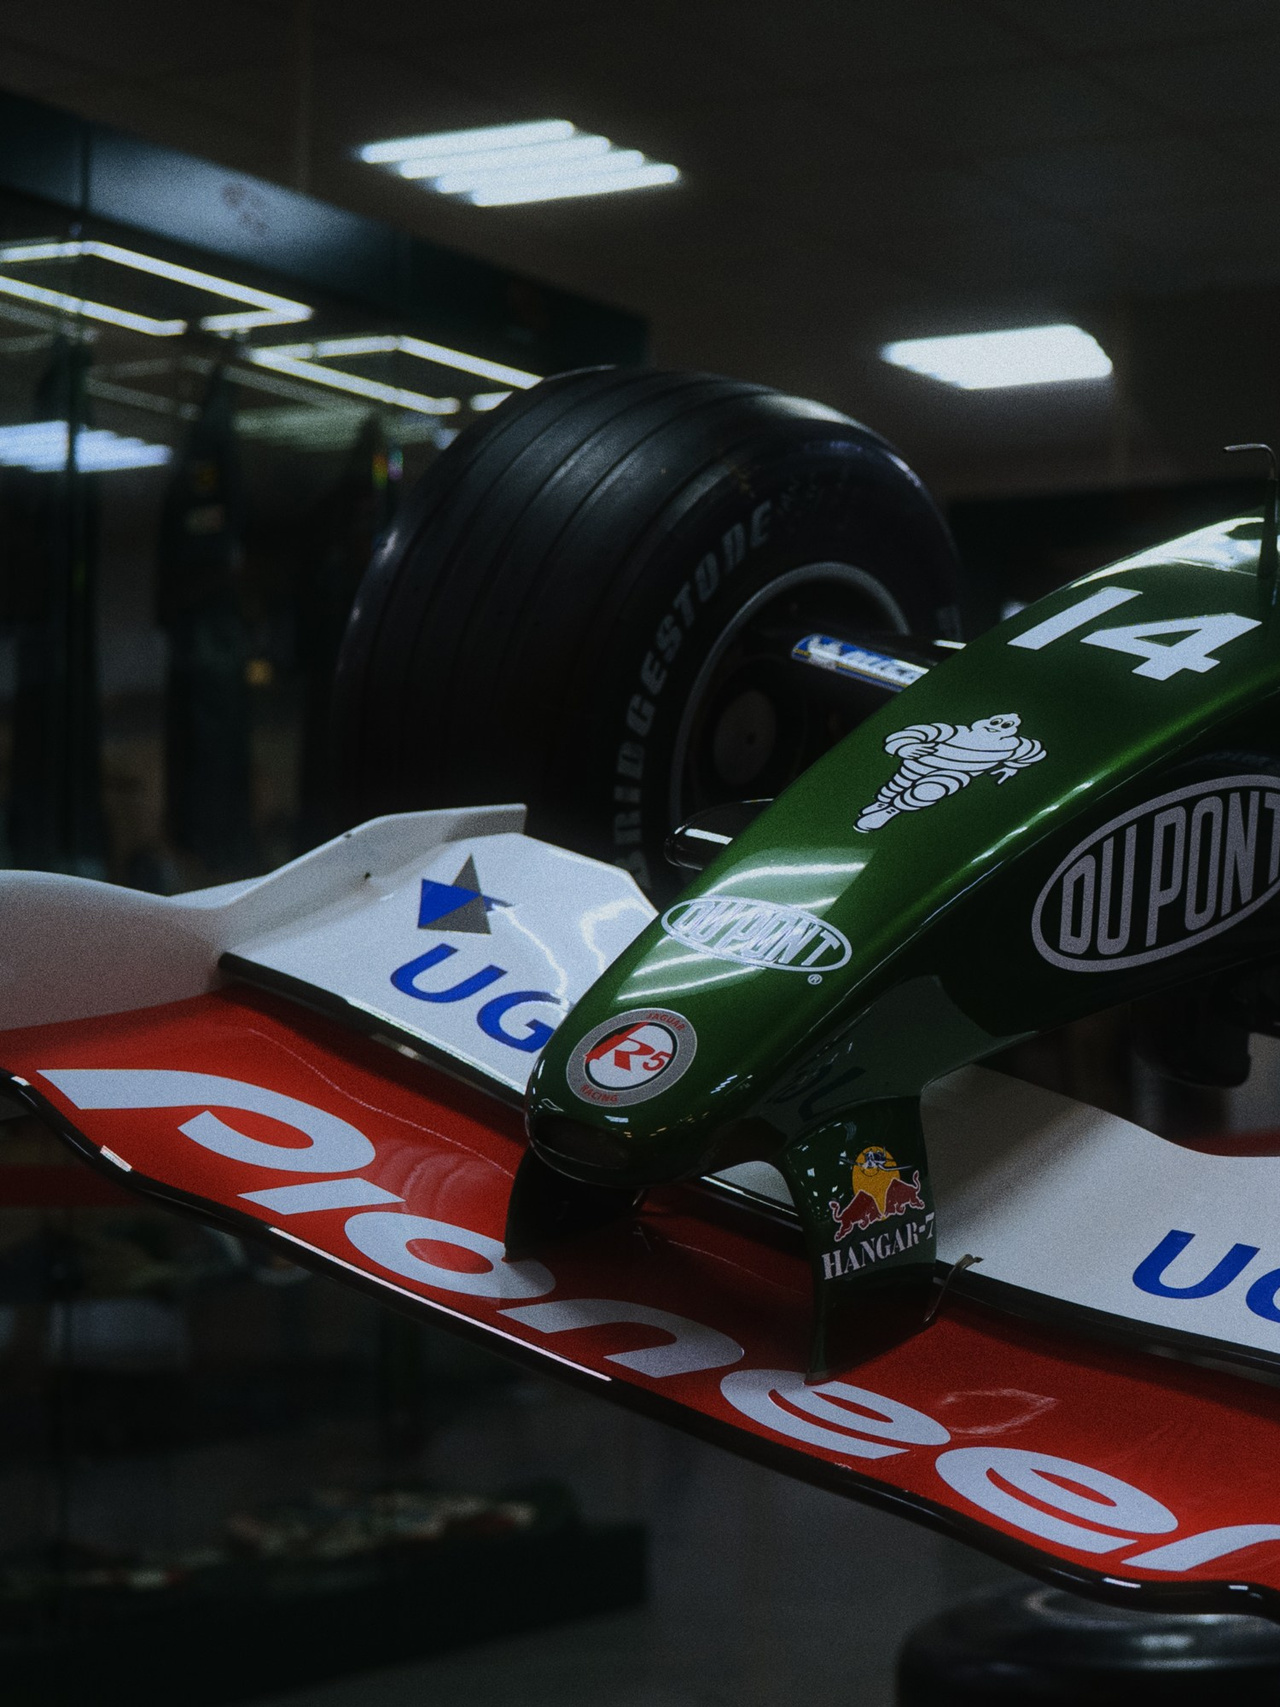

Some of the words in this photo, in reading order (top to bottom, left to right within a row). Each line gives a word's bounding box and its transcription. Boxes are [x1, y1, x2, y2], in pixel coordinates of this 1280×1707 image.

[1006, 585, 1263, 682] 14
[645, 1012, 686, 1031] JAGUAR
[580, 1084, 619, 1103] RACING
[820, 1211, 936, 1281] HANGAR-7
